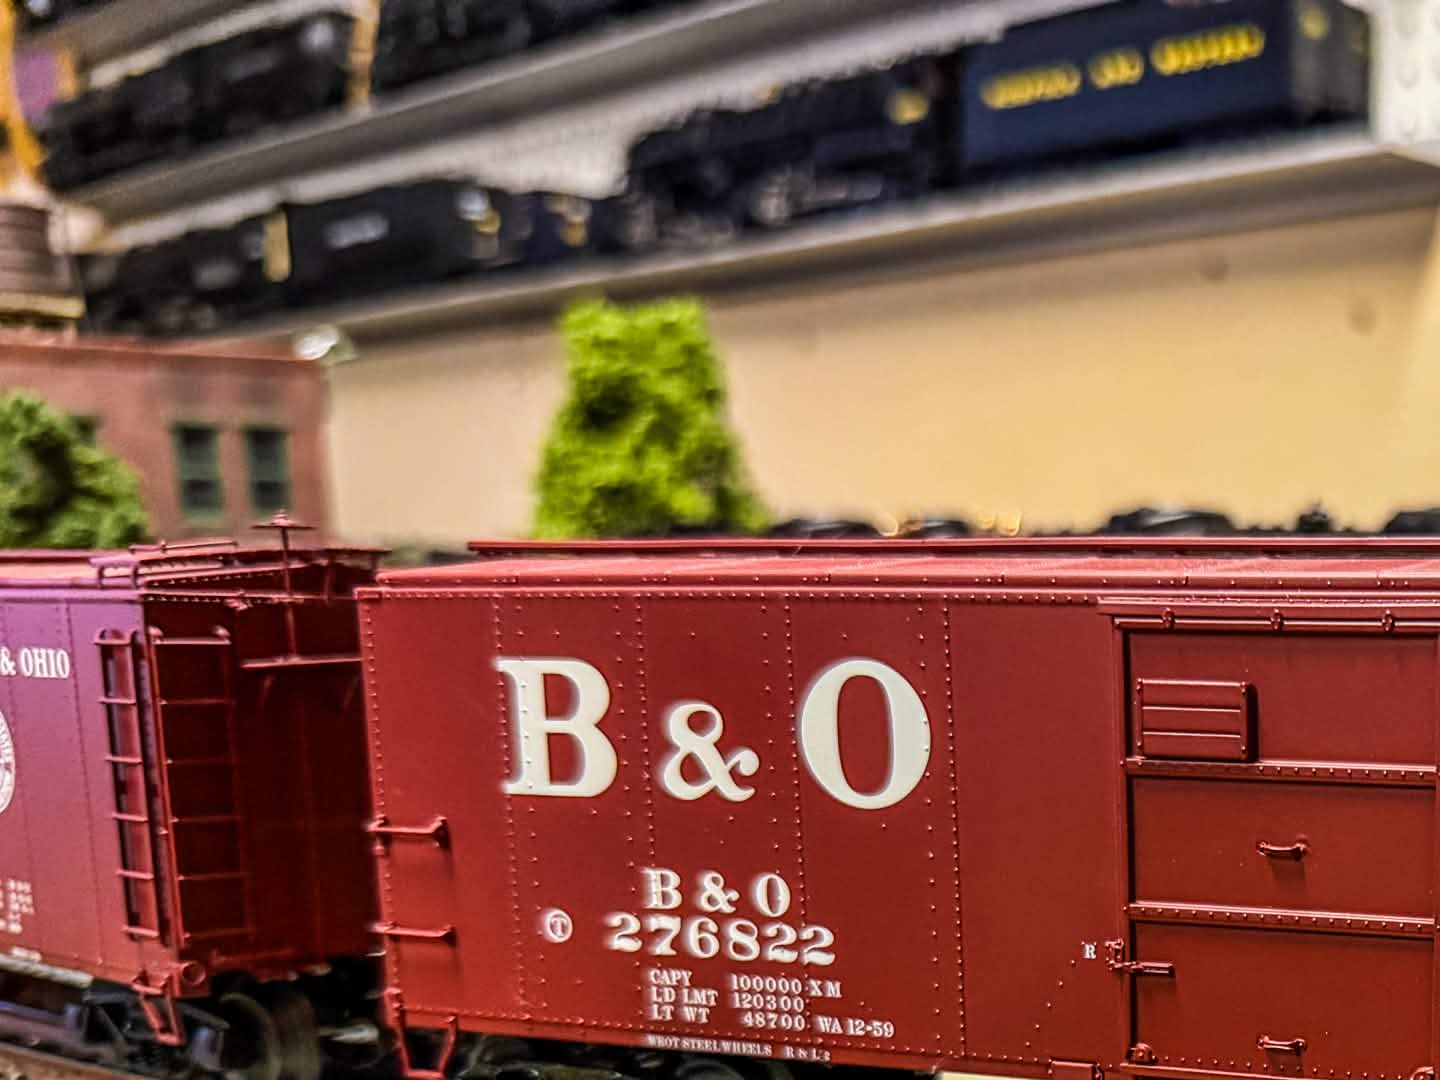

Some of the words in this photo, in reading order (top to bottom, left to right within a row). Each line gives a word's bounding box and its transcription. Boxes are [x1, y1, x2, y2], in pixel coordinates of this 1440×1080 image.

[20, 647, 70, 679] OHIO
[494, 657, 617, 797] B
[660, 702, 760, 802] &
[801, 658, 931, 810] O
[606, 911, 836, 966] 276822
[1084, 943, 1097, 959] R
[649, 968, 692, 987] CAPY
[731, 974, 802, 995] 100000
[651, 986, 676, 1004] LD
[682, 988, 719, 1007] LMT
[733, 992, 805, 1012] 120300
[651, 1003, 674, 1021] LT
[682, 1006, 710, 1024] WT
[743, 1012, 806, 1031] 48700
[816, 1015, 843, 1034] WA
[848, 1018, 895, 1038] 12-59
[681, 1038, 720, 1052] STEEL
[720, 1041, 773, 1057] WHEELS
